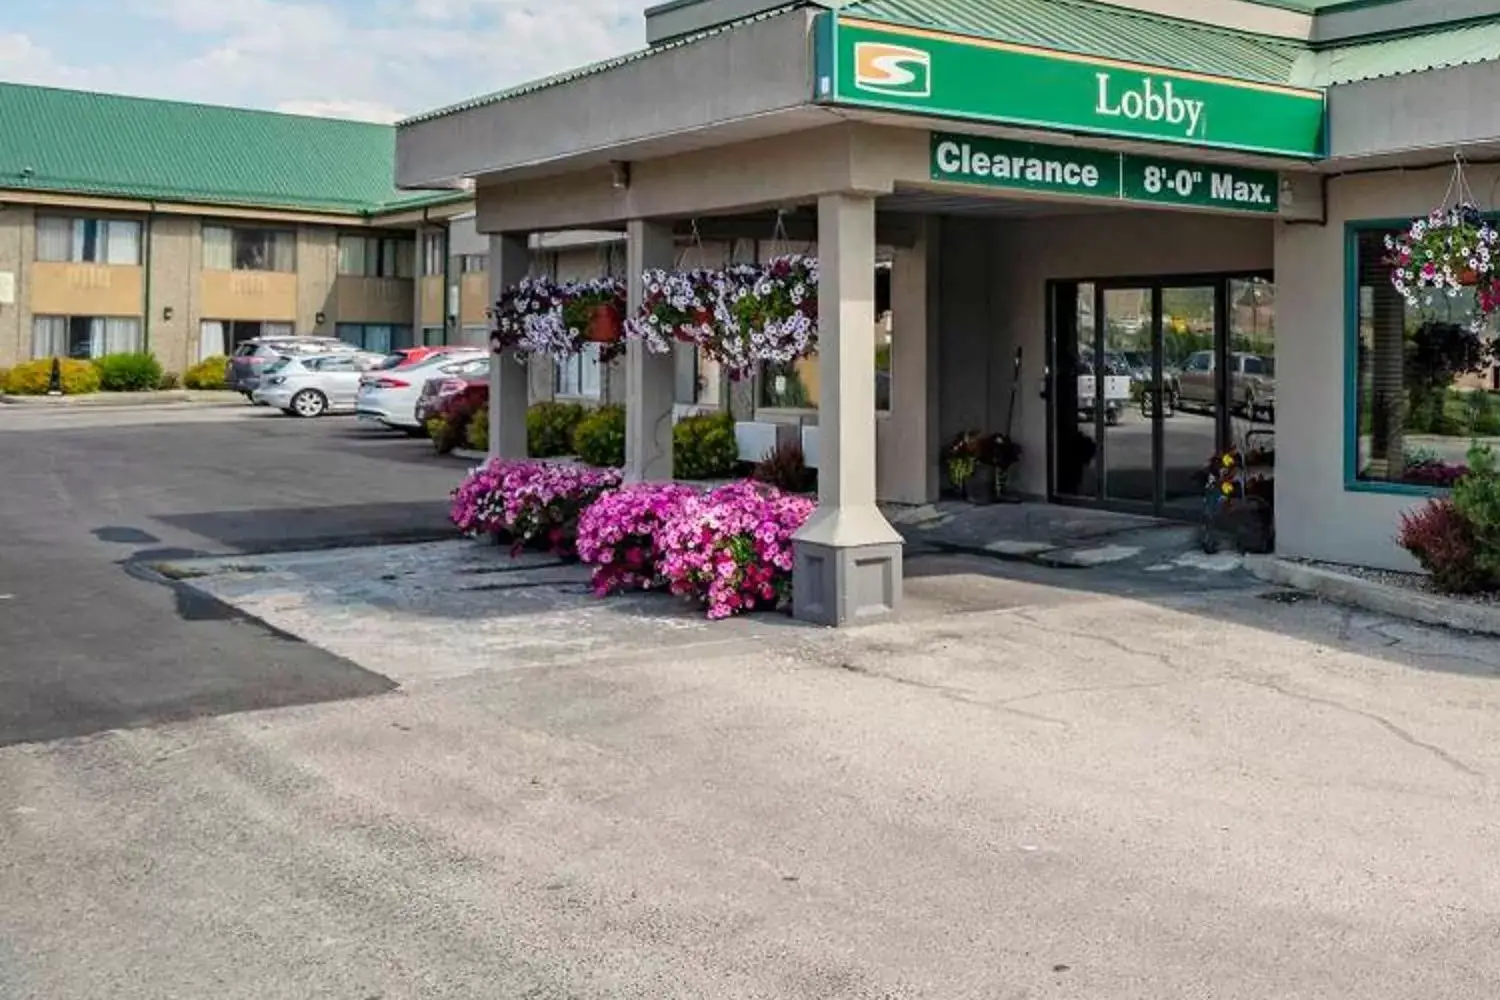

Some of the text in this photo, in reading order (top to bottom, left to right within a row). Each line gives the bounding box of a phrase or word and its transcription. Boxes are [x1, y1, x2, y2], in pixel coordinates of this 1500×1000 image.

[1095, 72, 1204, 137] Lobby
[936, 140, 1100, 187] Clearance
[1210, 172, 1272, 204] Max.
